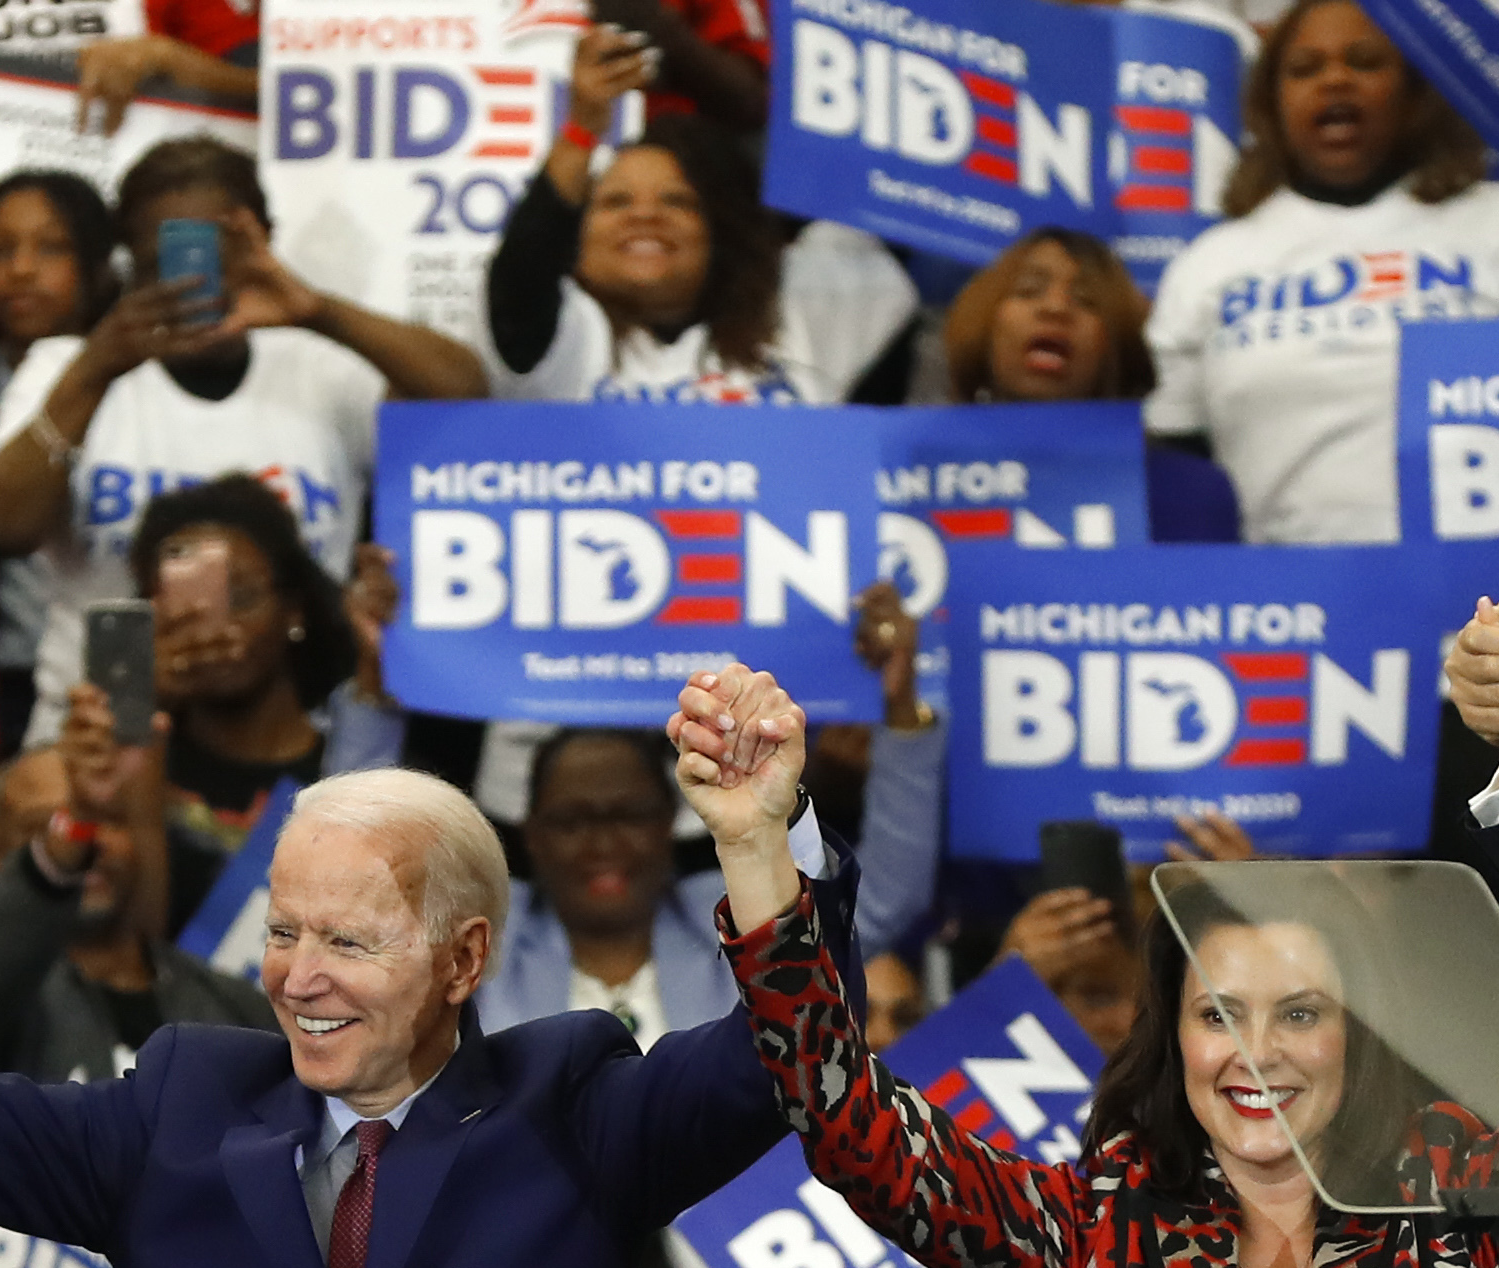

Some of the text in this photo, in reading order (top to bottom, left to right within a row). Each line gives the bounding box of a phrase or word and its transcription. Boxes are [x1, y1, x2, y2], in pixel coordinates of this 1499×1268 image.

[271, 16, 481, 51] SUPPORTS
[1116, 60, 1208, 104] FOR
[792, 18, 1094, 206] BIDEN
[1220, 251, 1473, 326] BIDEN
[410, 459, 760, 501] MICHIGAN FOR
[934, 459, 1031, 502] FOR
[411, 508, 851, 630] BIDEN
[980, 601, 1328, 645] MICHIGAN FOR
[981, 648, 1411, 772] BIDEN
